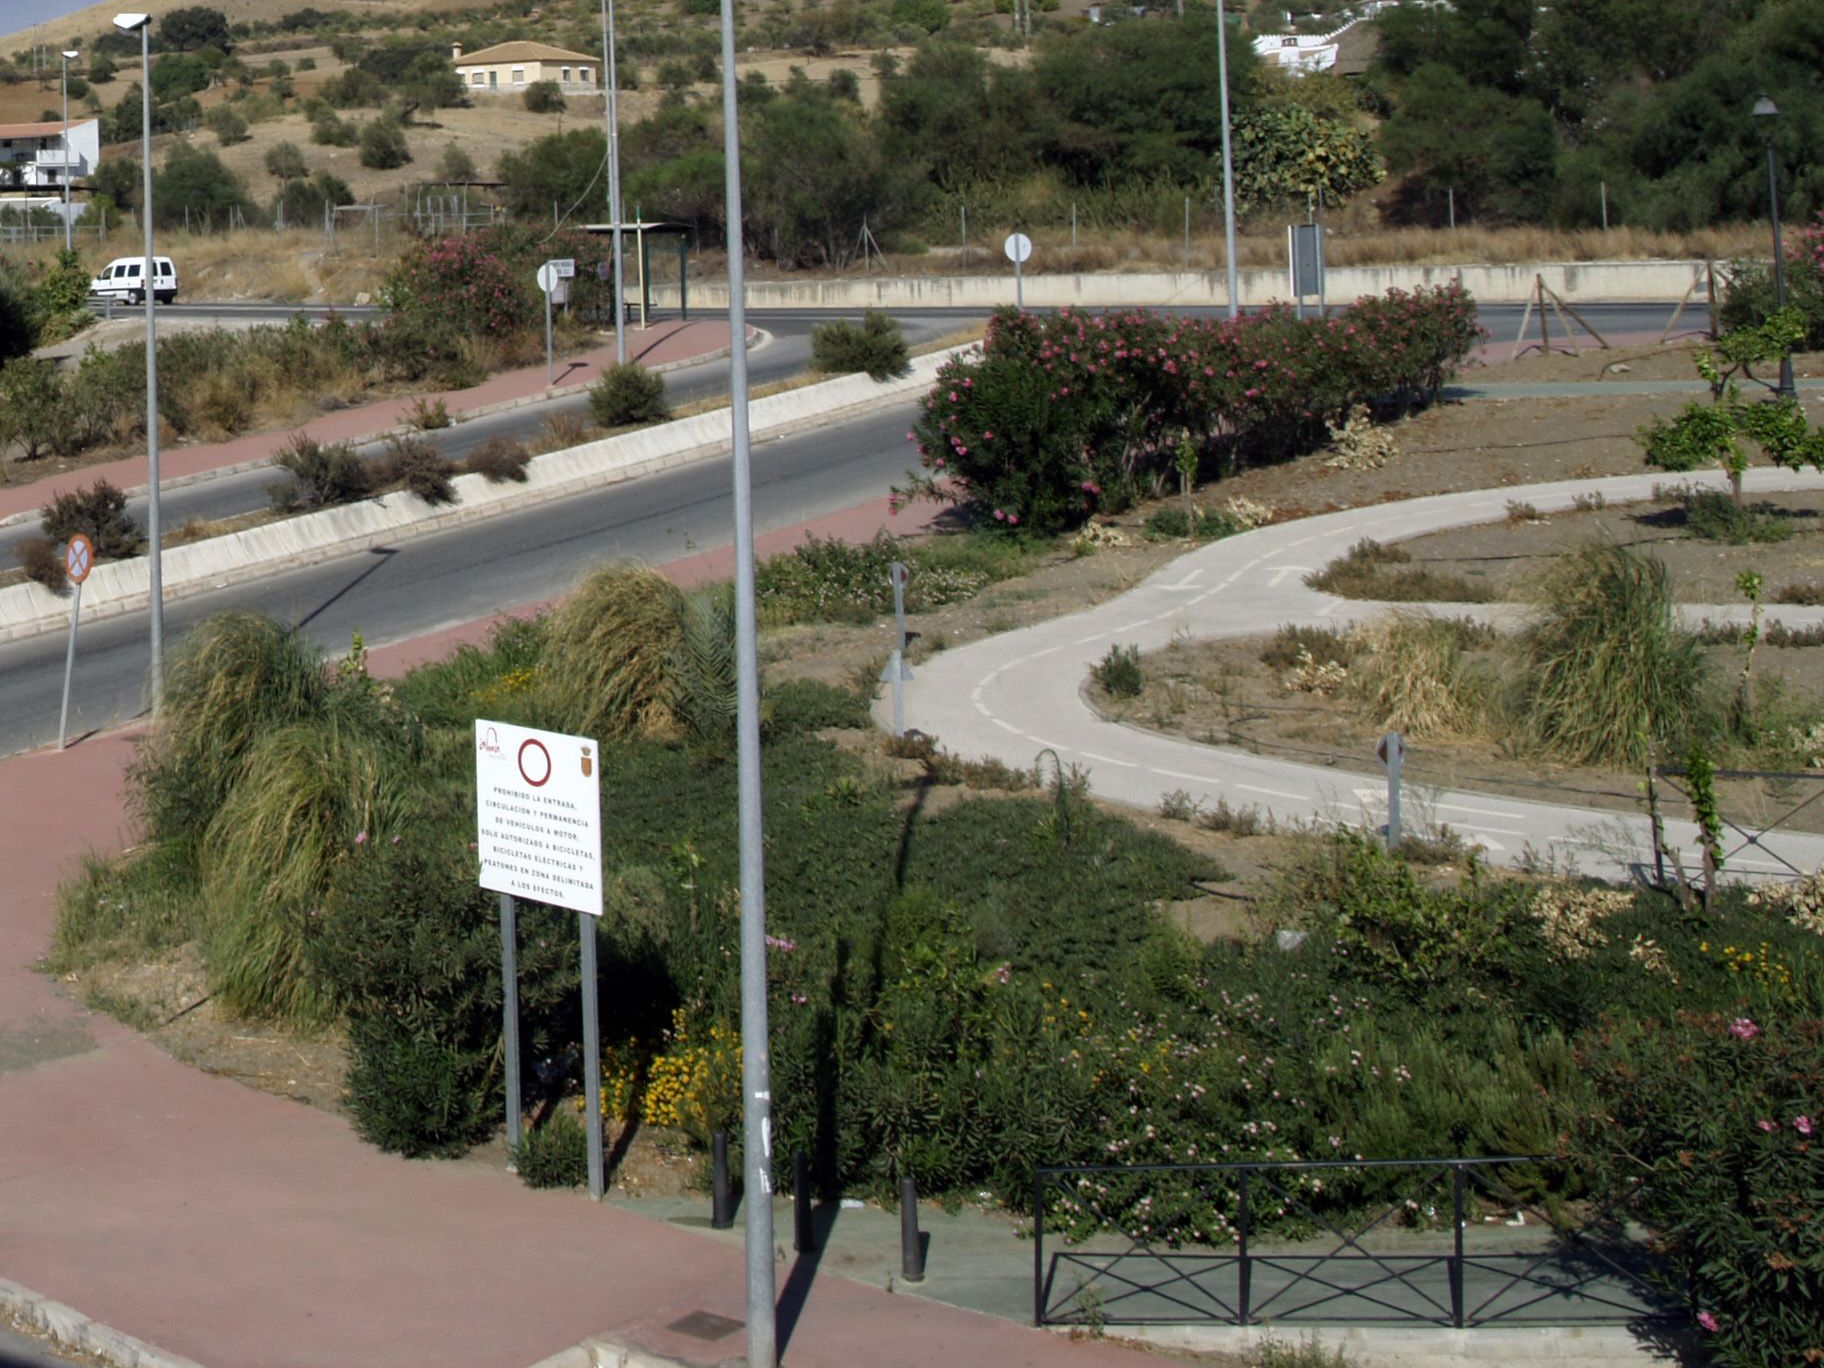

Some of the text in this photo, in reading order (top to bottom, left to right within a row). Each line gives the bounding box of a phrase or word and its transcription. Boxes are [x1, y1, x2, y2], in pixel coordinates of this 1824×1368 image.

[494, 786, 530, 800] PROHIBIDO
[540, 812, 588, 827] PERMANENCIA
[501, 832, 543, 848] AUTORIZADO
[493, 845, 531, 860] BICICLETAS
[484, 858, 594, 890] PEATONES EN ZONA DELIMITADA
[517, 881, 530, 890] LOS
